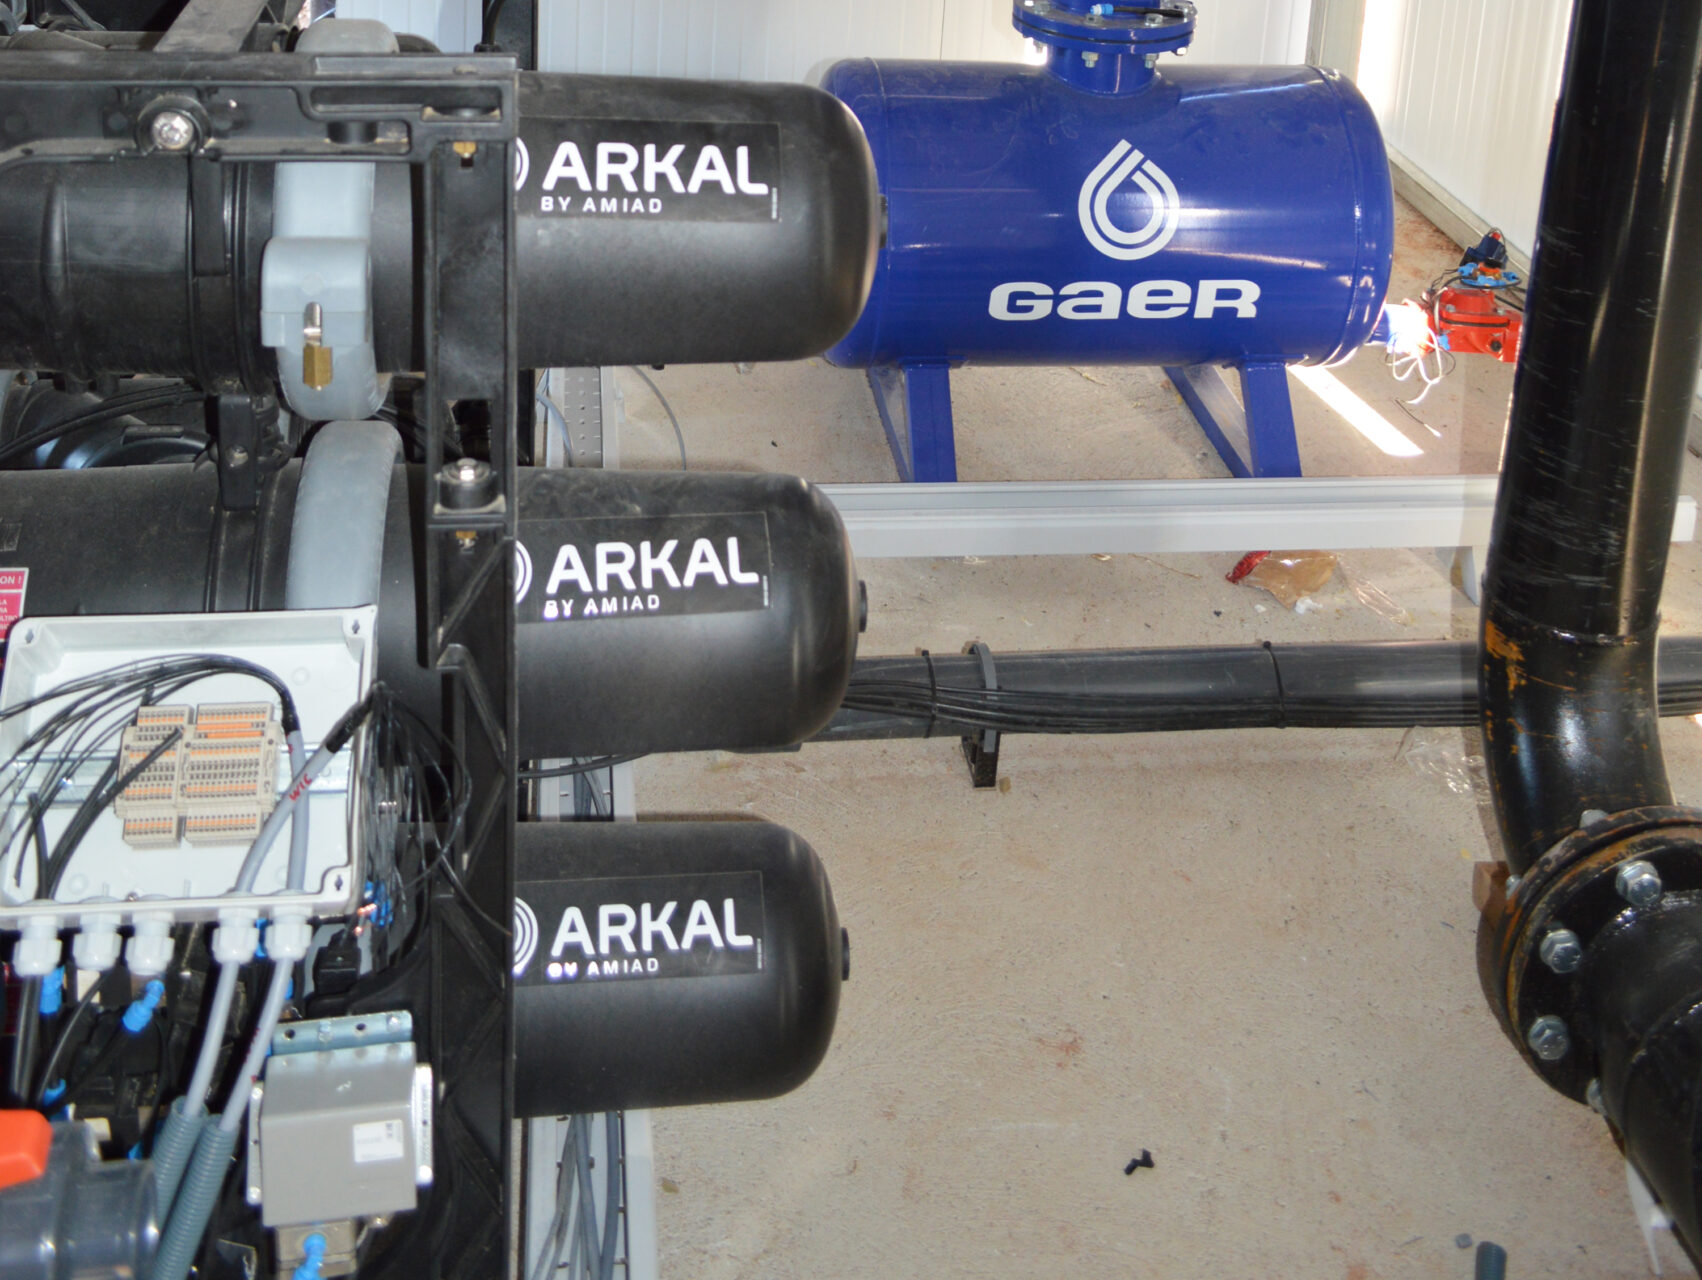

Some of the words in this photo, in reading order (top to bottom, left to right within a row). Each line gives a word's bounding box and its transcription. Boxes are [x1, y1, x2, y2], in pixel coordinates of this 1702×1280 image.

[542, 141, 769, 195] ARKAL
[540, 196, 572, 212] BY
[582, 197, 662, 214] AMIAD
[546, 536, 760, 595] ARKAL
[543, 599, 574, 619] BY
[583, 594, 661, 616] AMIAD
[551, 898, 754, 958] ARKAL
[586, 957, 660, 976] AMIAD
